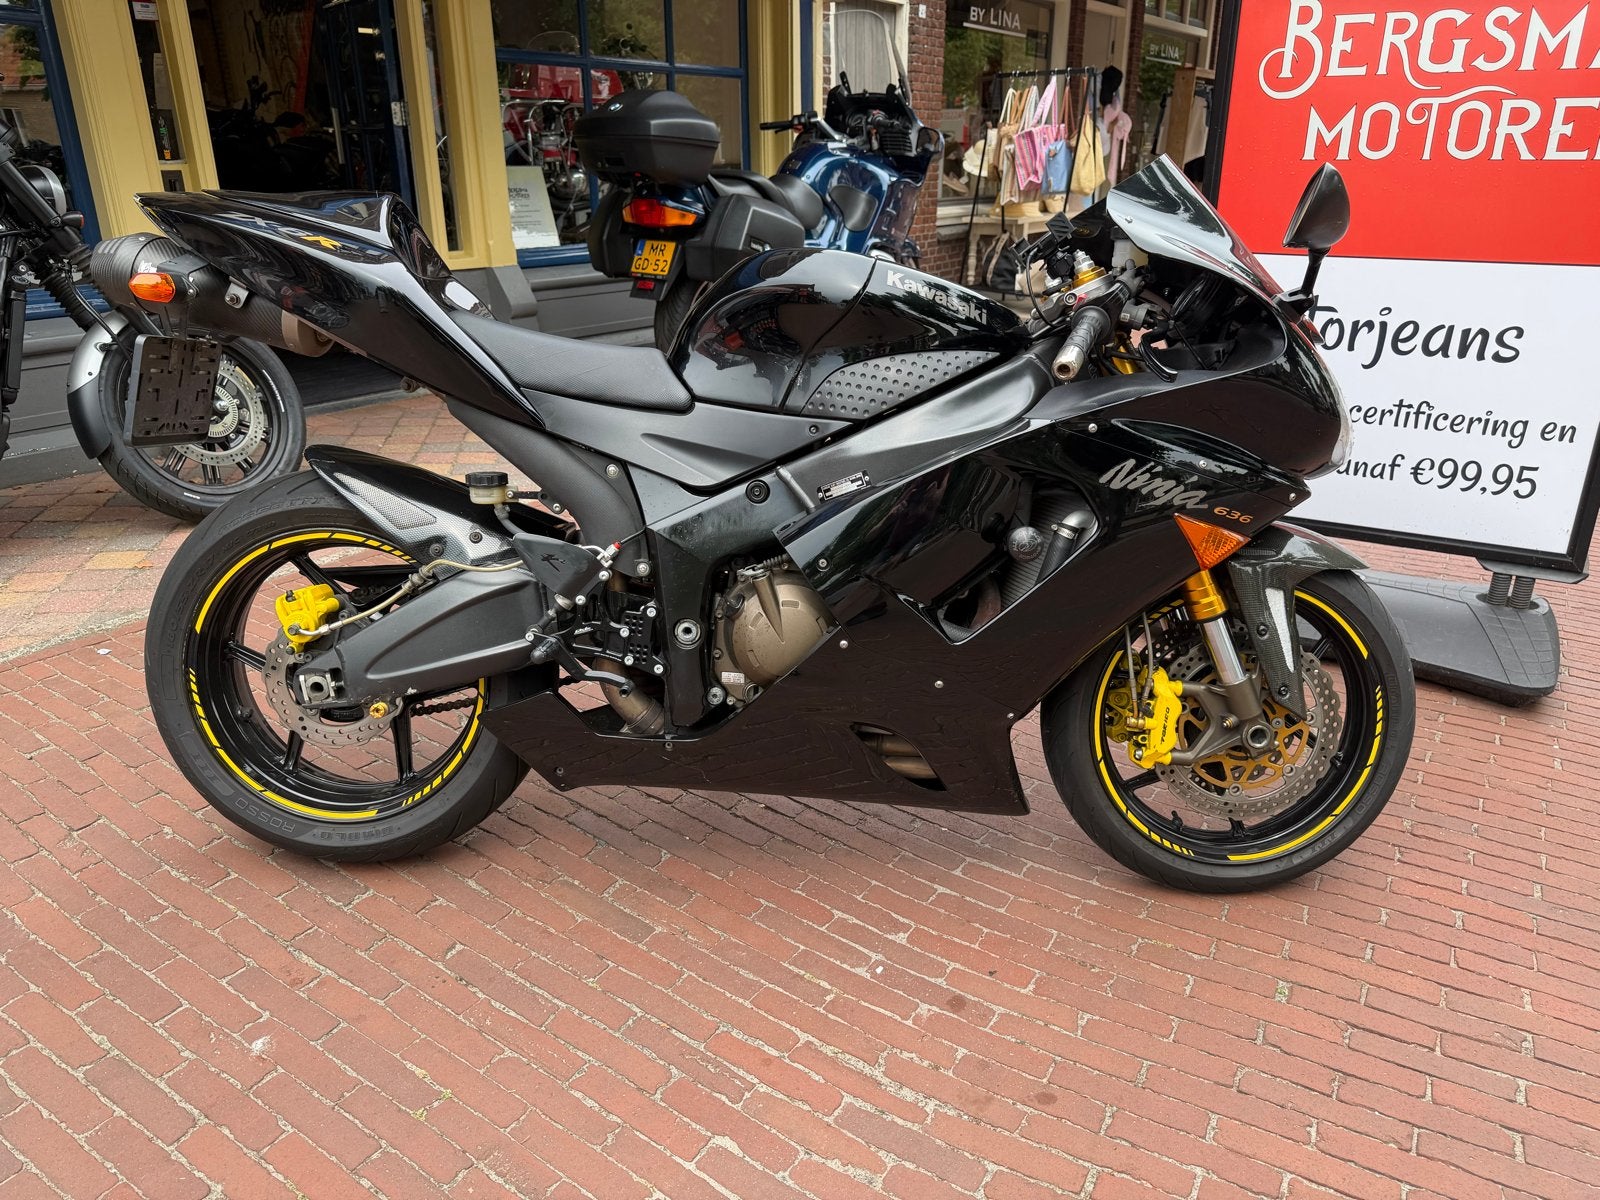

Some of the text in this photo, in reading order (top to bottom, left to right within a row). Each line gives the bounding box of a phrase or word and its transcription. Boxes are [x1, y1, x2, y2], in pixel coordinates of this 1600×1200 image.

[969, 6, 1021, 30] BY LINA
[1160, 43, 1180, 60] LINA
[1301, 85, 1600, 160] MOTORE
[648, 242, 667, 256] MR
[887, 270, 988, 325] Kawasaki
[1349, 398, 1577, 449] certificering en
[1098, 458, 1208, 509] Ninja
[1409, 456, 1540, 500] €99,95
[1213, 506, 1253, 524] 636
[233, 795, 297, 835] ROSSO
